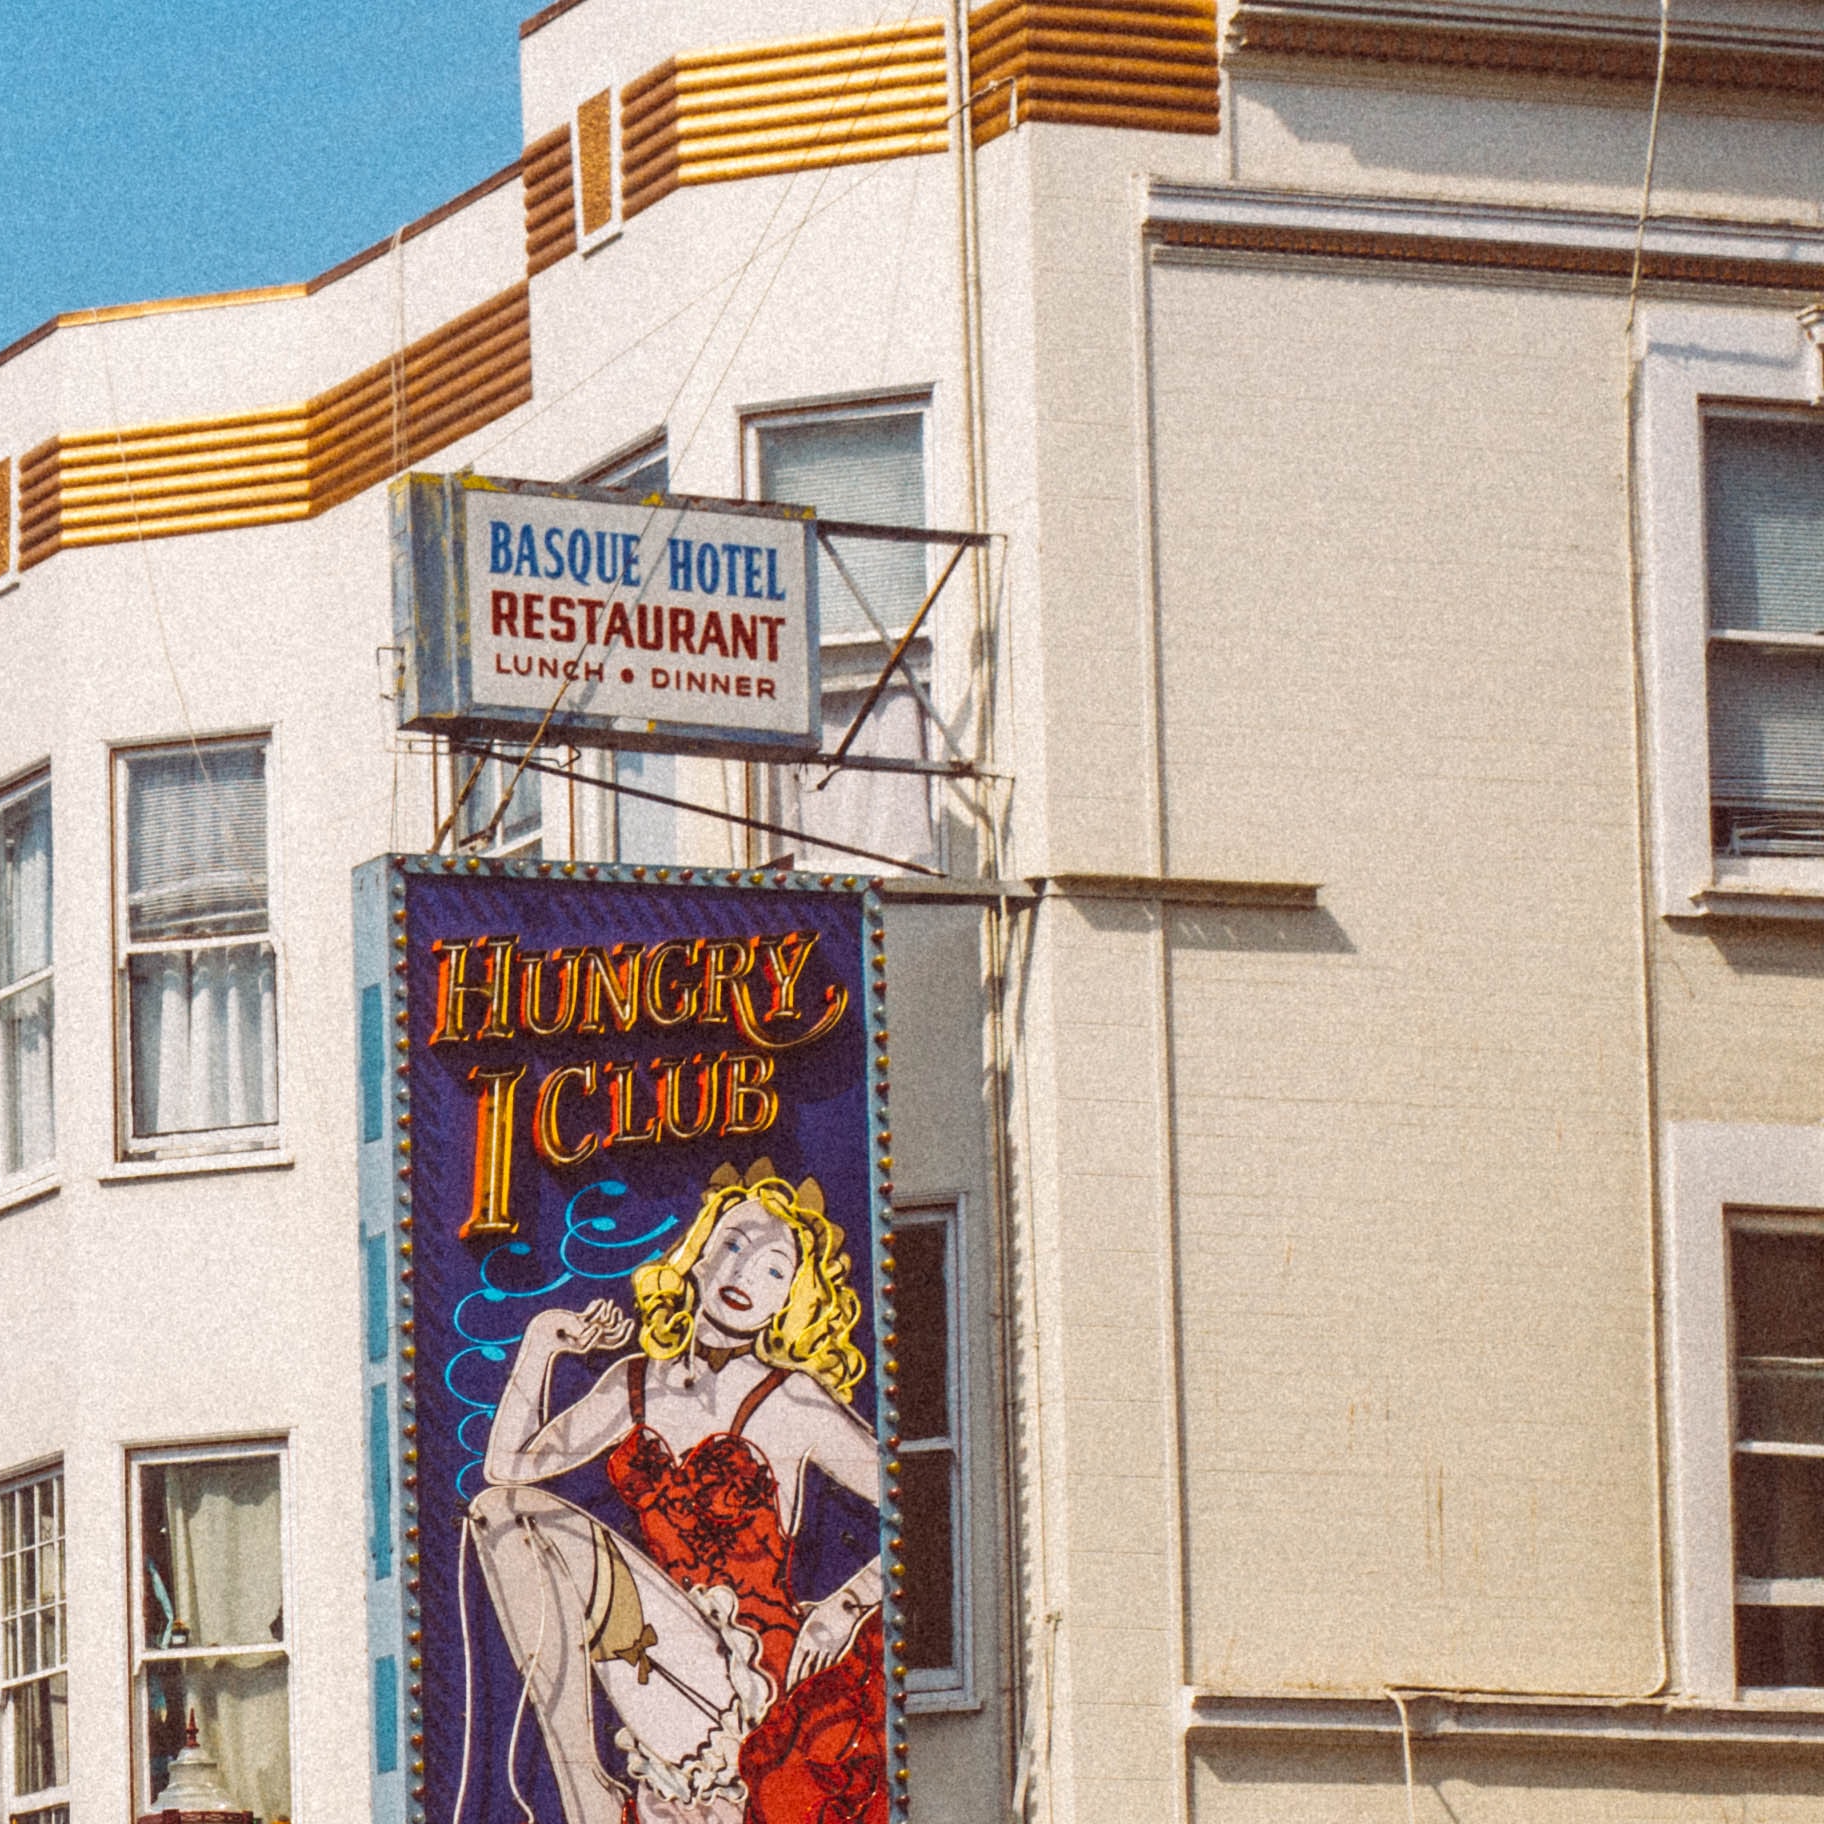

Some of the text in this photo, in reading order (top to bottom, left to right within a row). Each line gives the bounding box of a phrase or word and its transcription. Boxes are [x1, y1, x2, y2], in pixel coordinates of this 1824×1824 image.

[489, 520, 786, 602] BASQUE HOTEL
[490, 589, 785, 662] RESTAURANT
[495, 652, 777, 701] LUNCH DINNER
[428, 929, 849, 1049] HUNGRY
[532, 1052, 780, 1167] CLUB
